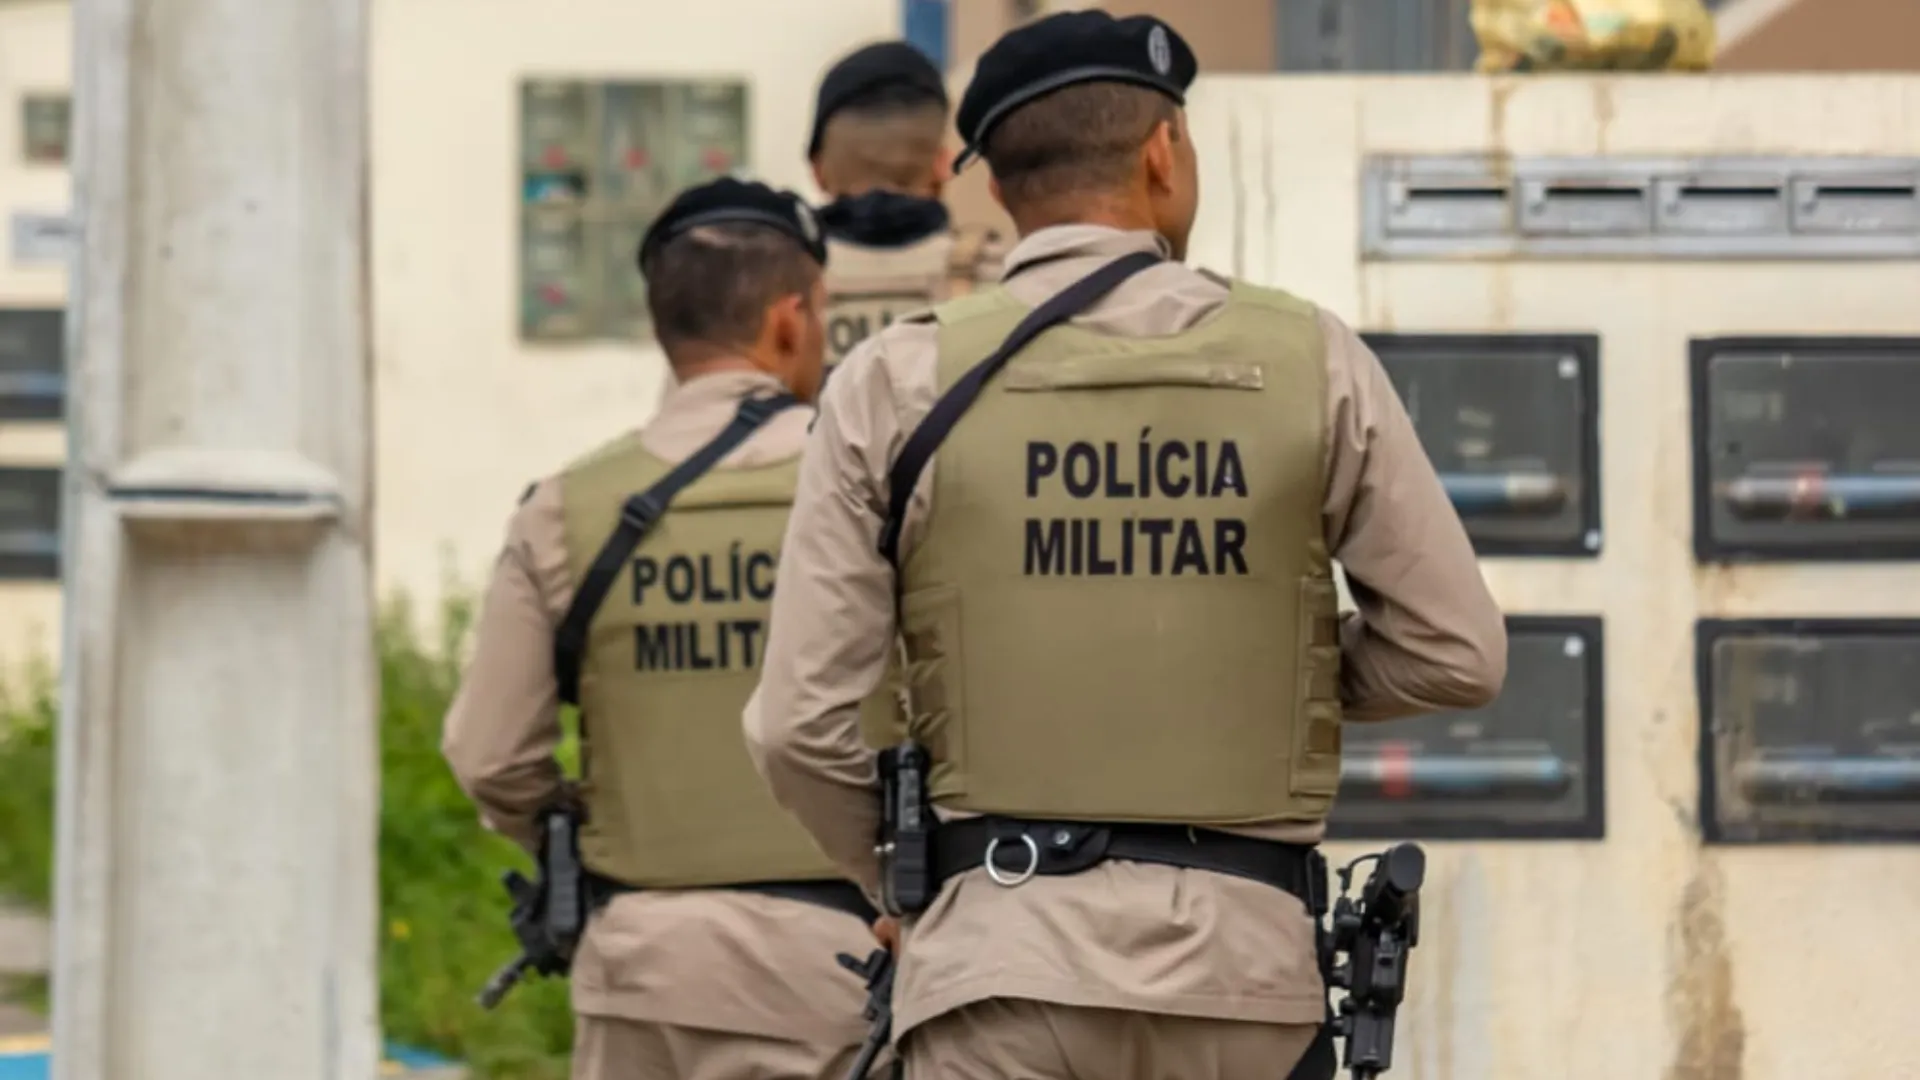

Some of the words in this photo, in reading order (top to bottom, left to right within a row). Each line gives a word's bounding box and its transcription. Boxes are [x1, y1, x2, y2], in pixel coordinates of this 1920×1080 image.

[1026, 426, 1249, 499] POLÍCIA
[1023, 518, 1249, 576] MILITAR
[635, 620, 761, 672] MILIT
